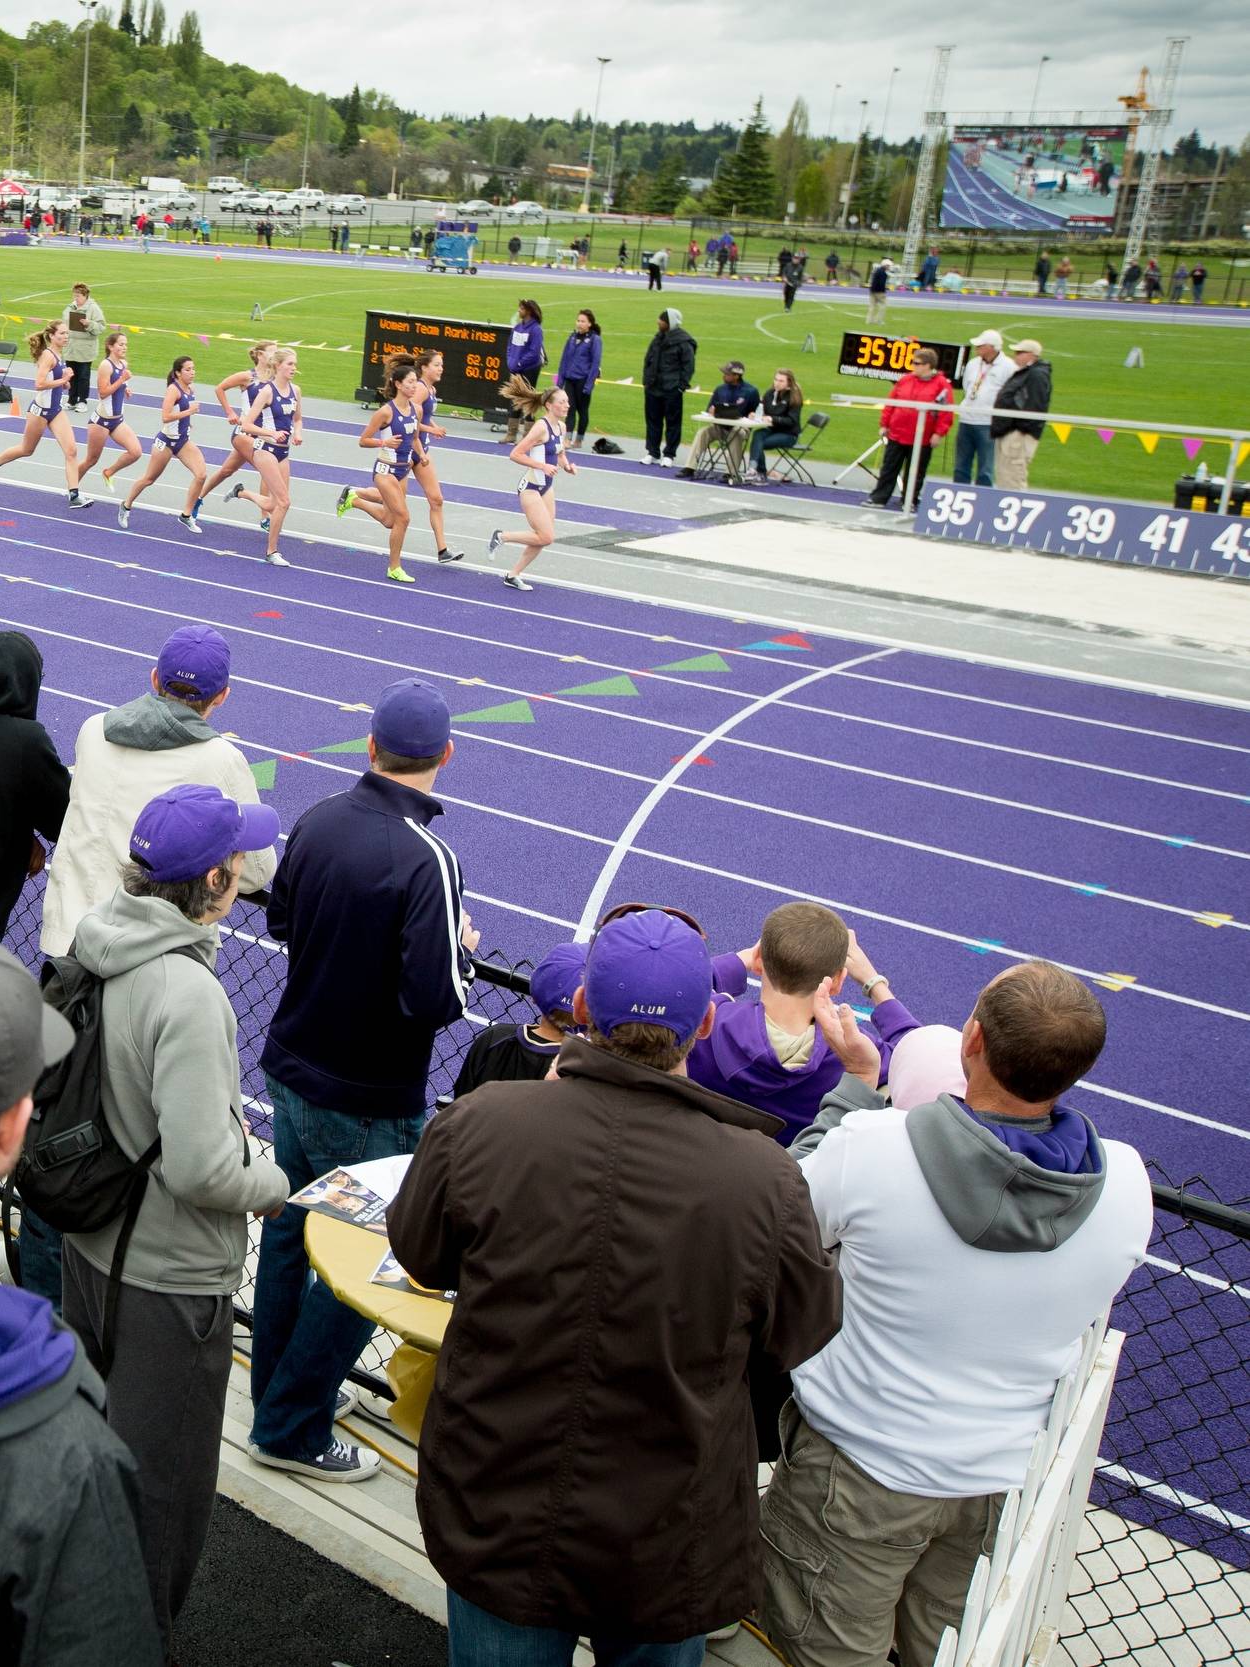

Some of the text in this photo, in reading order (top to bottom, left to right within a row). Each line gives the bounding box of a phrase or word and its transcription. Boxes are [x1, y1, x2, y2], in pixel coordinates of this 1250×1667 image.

[379, 319, 410, 332] Women
[415, 323, 440, 336] Team
[444, 326, 496, 343] Rankings
[466, 353, 500, 369] 62.00
[465, 367, 499, 381] 60.00
[927, 488, 977, 526] 35
[993, 496, 1046, 534] 37
[1061, 505, 1116, 544] 39
[1139, 514, 1189, 553] 41
[176, 670, 196, 679] ALUM
[630, 1003, 666, 1015] ALUM
